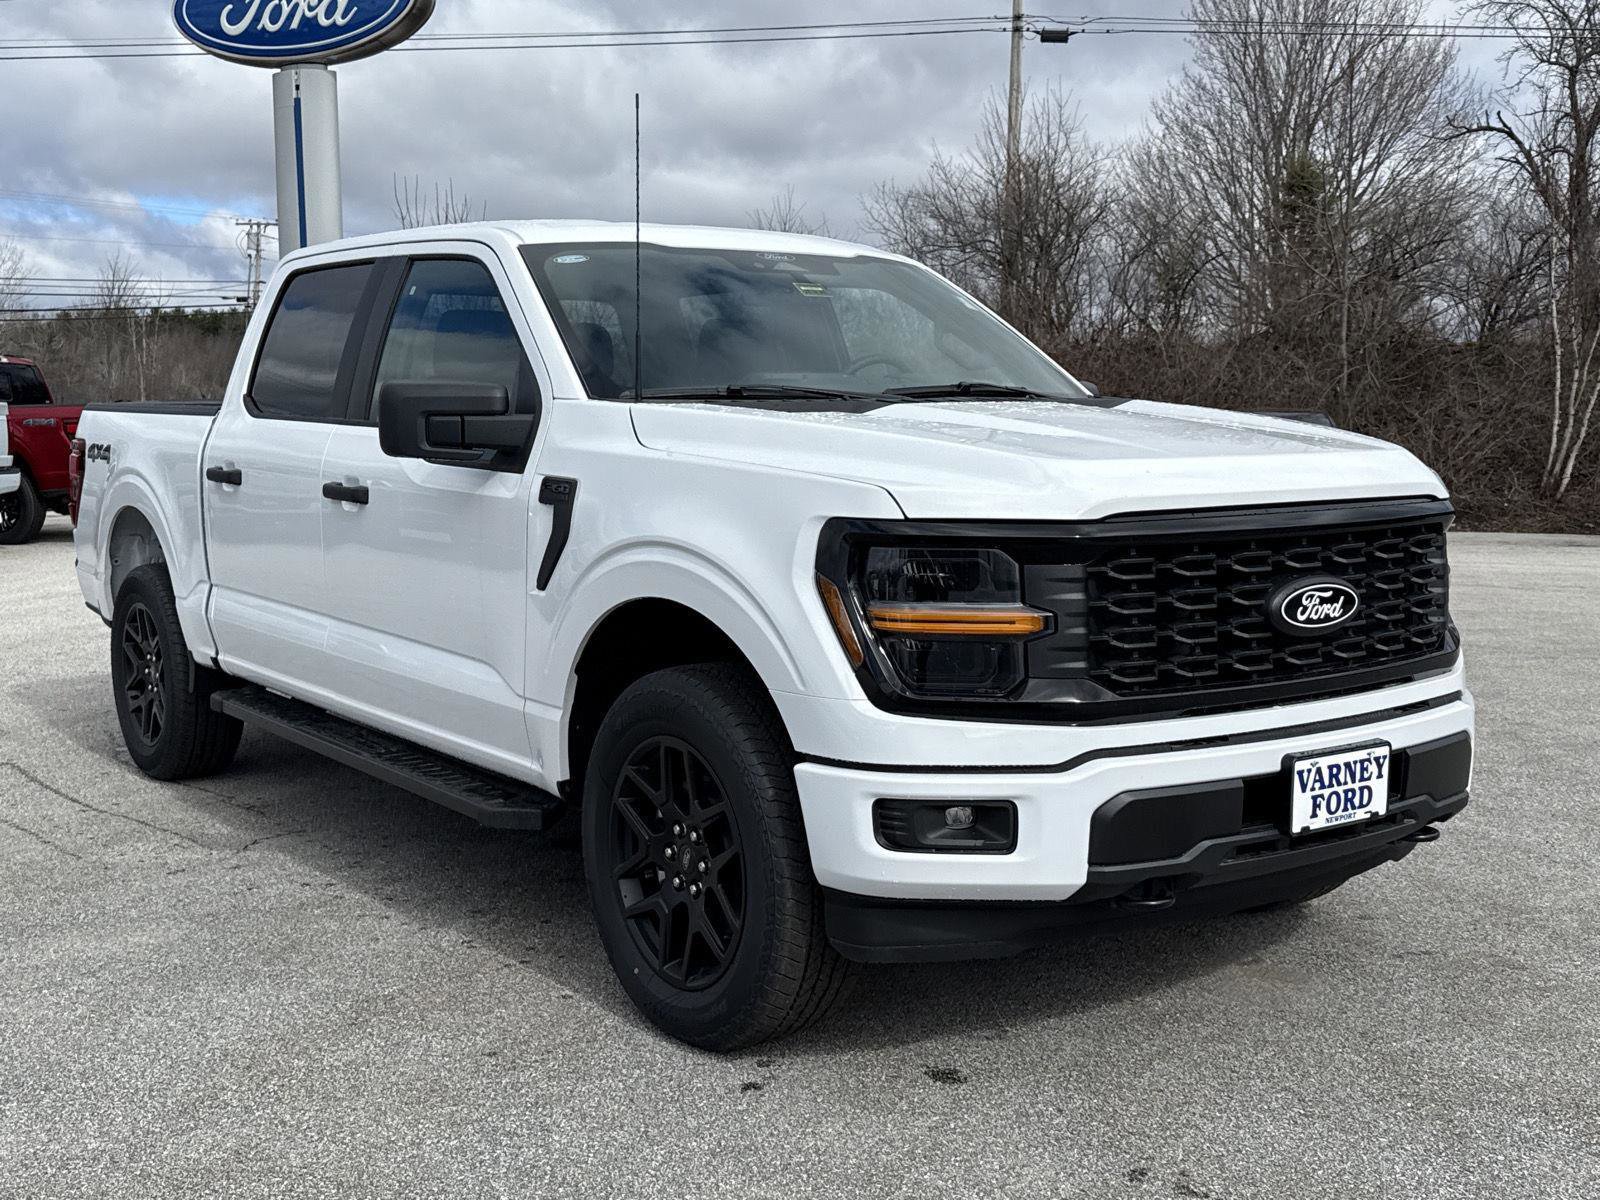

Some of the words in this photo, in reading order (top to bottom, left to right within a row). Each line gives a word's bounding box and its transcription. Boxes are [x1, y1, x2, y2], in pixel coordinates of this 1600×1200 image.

[1296, 590, 1344, 621] Ford
[1296, 754, 1388, 793] VARNEY
[1309, 785, 1373, 819] FORD
[1325, 812, 1357, 824] NEWPORT
